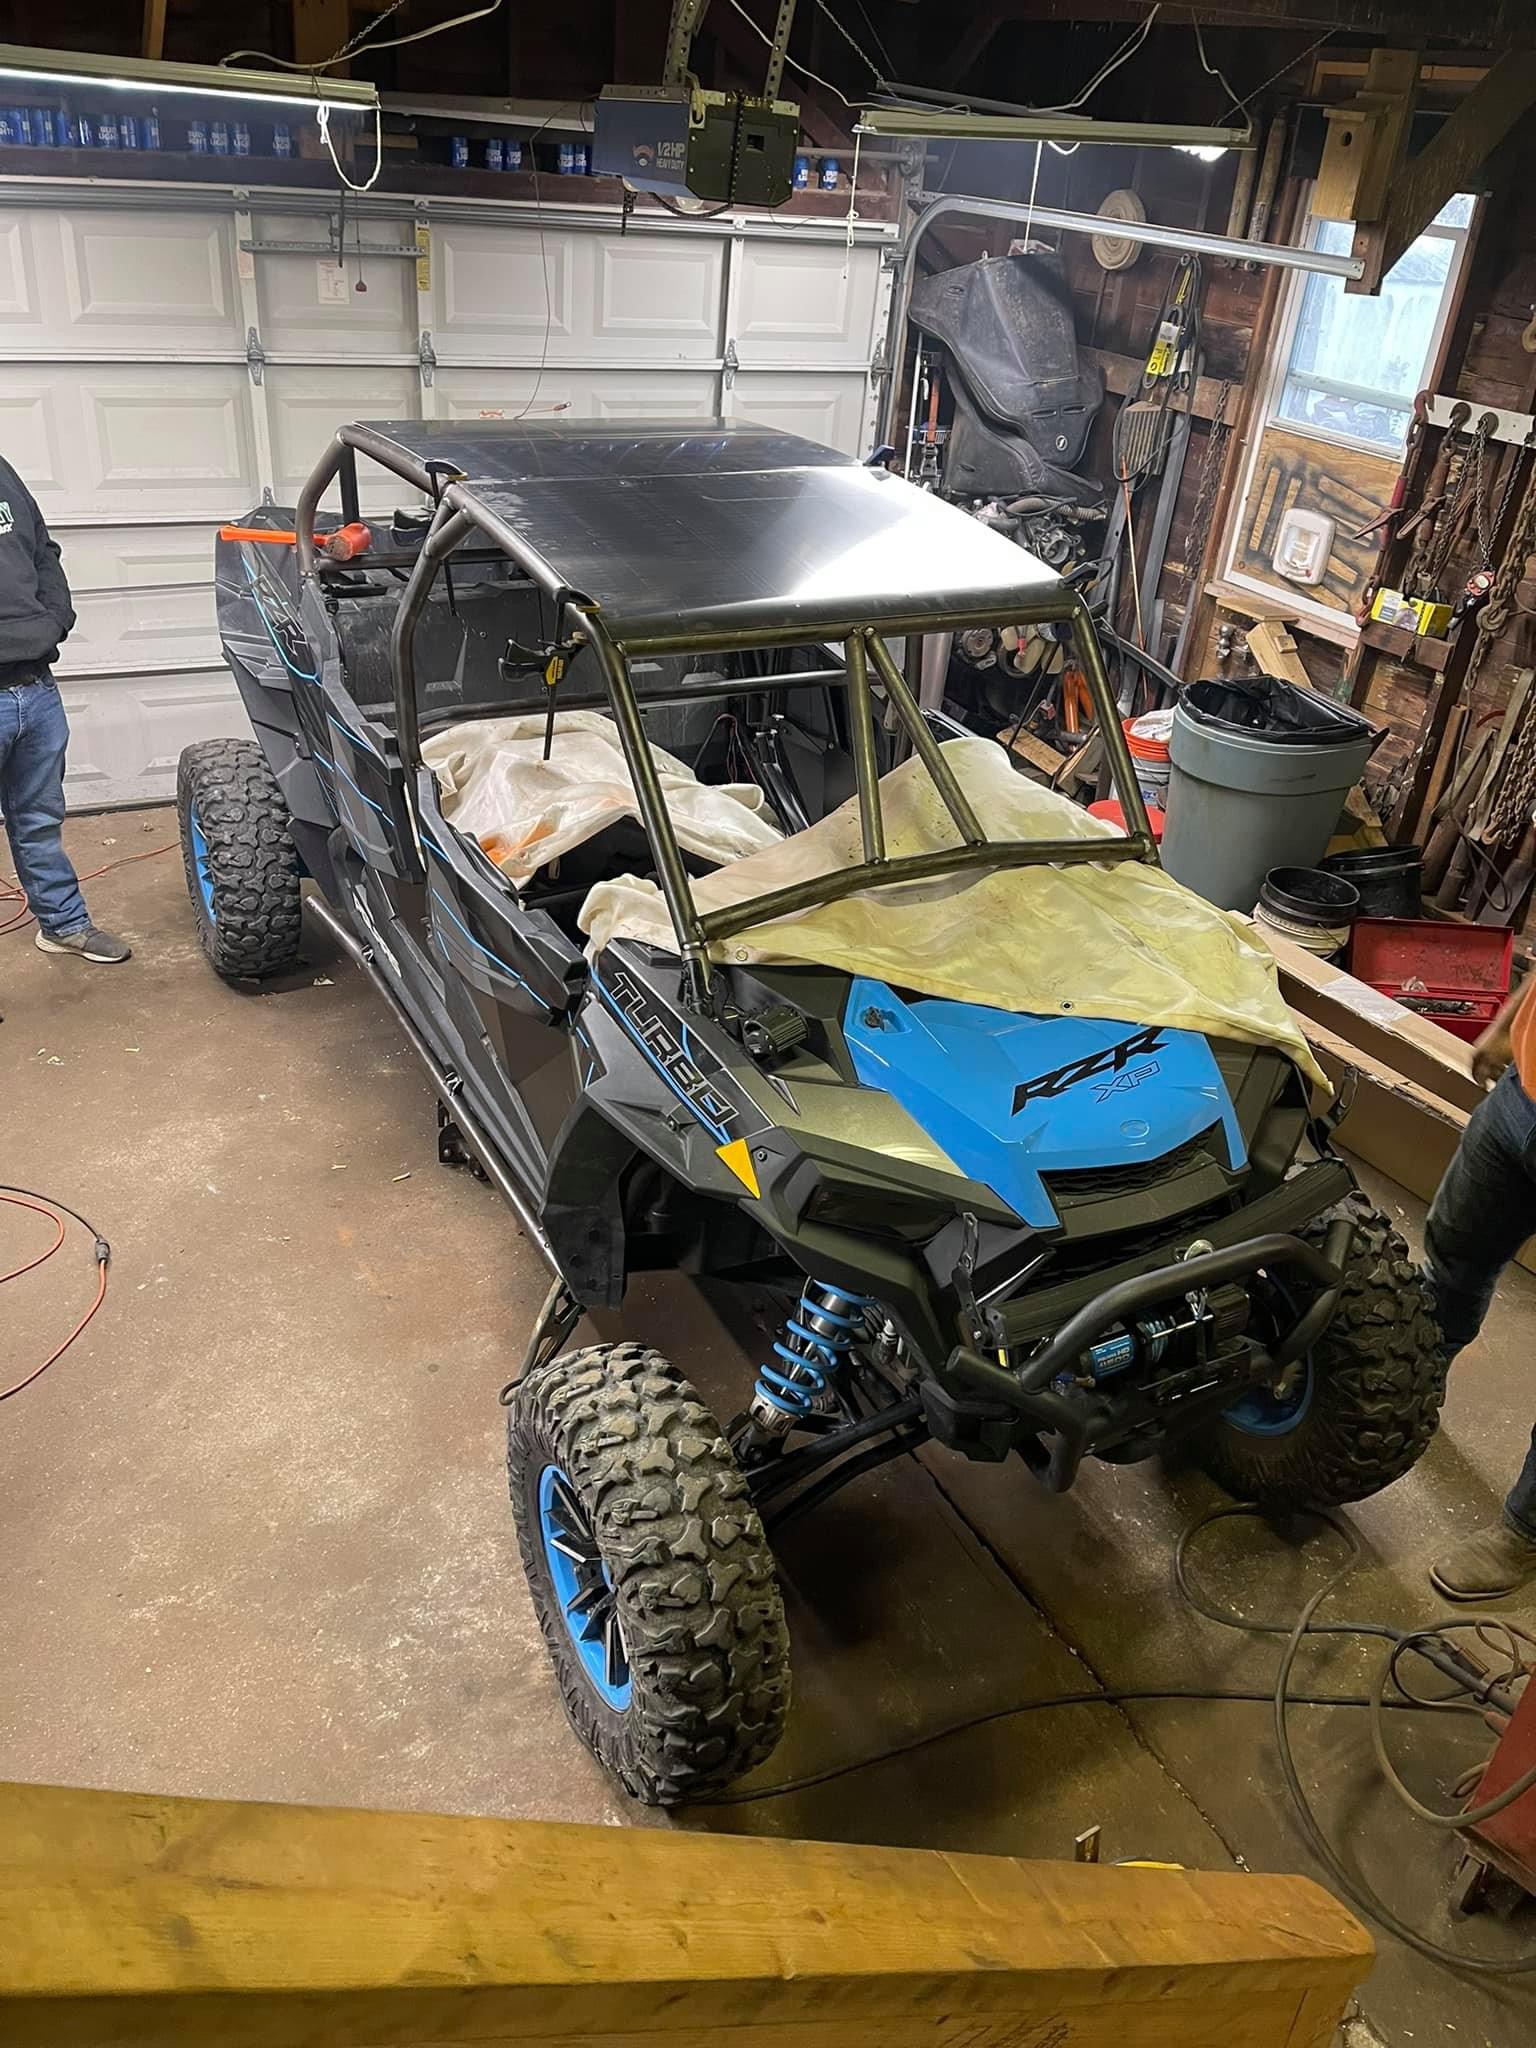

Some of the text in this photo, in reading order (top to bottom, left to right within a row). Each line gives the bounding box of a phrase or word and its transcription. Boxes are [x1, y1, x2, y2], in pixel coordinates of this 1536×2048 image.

[611, 972, 739, 1128] TURBO
[1012, 1024, 1169, 1116] RZR
[1090, 1060, 1160, 1104] XP
